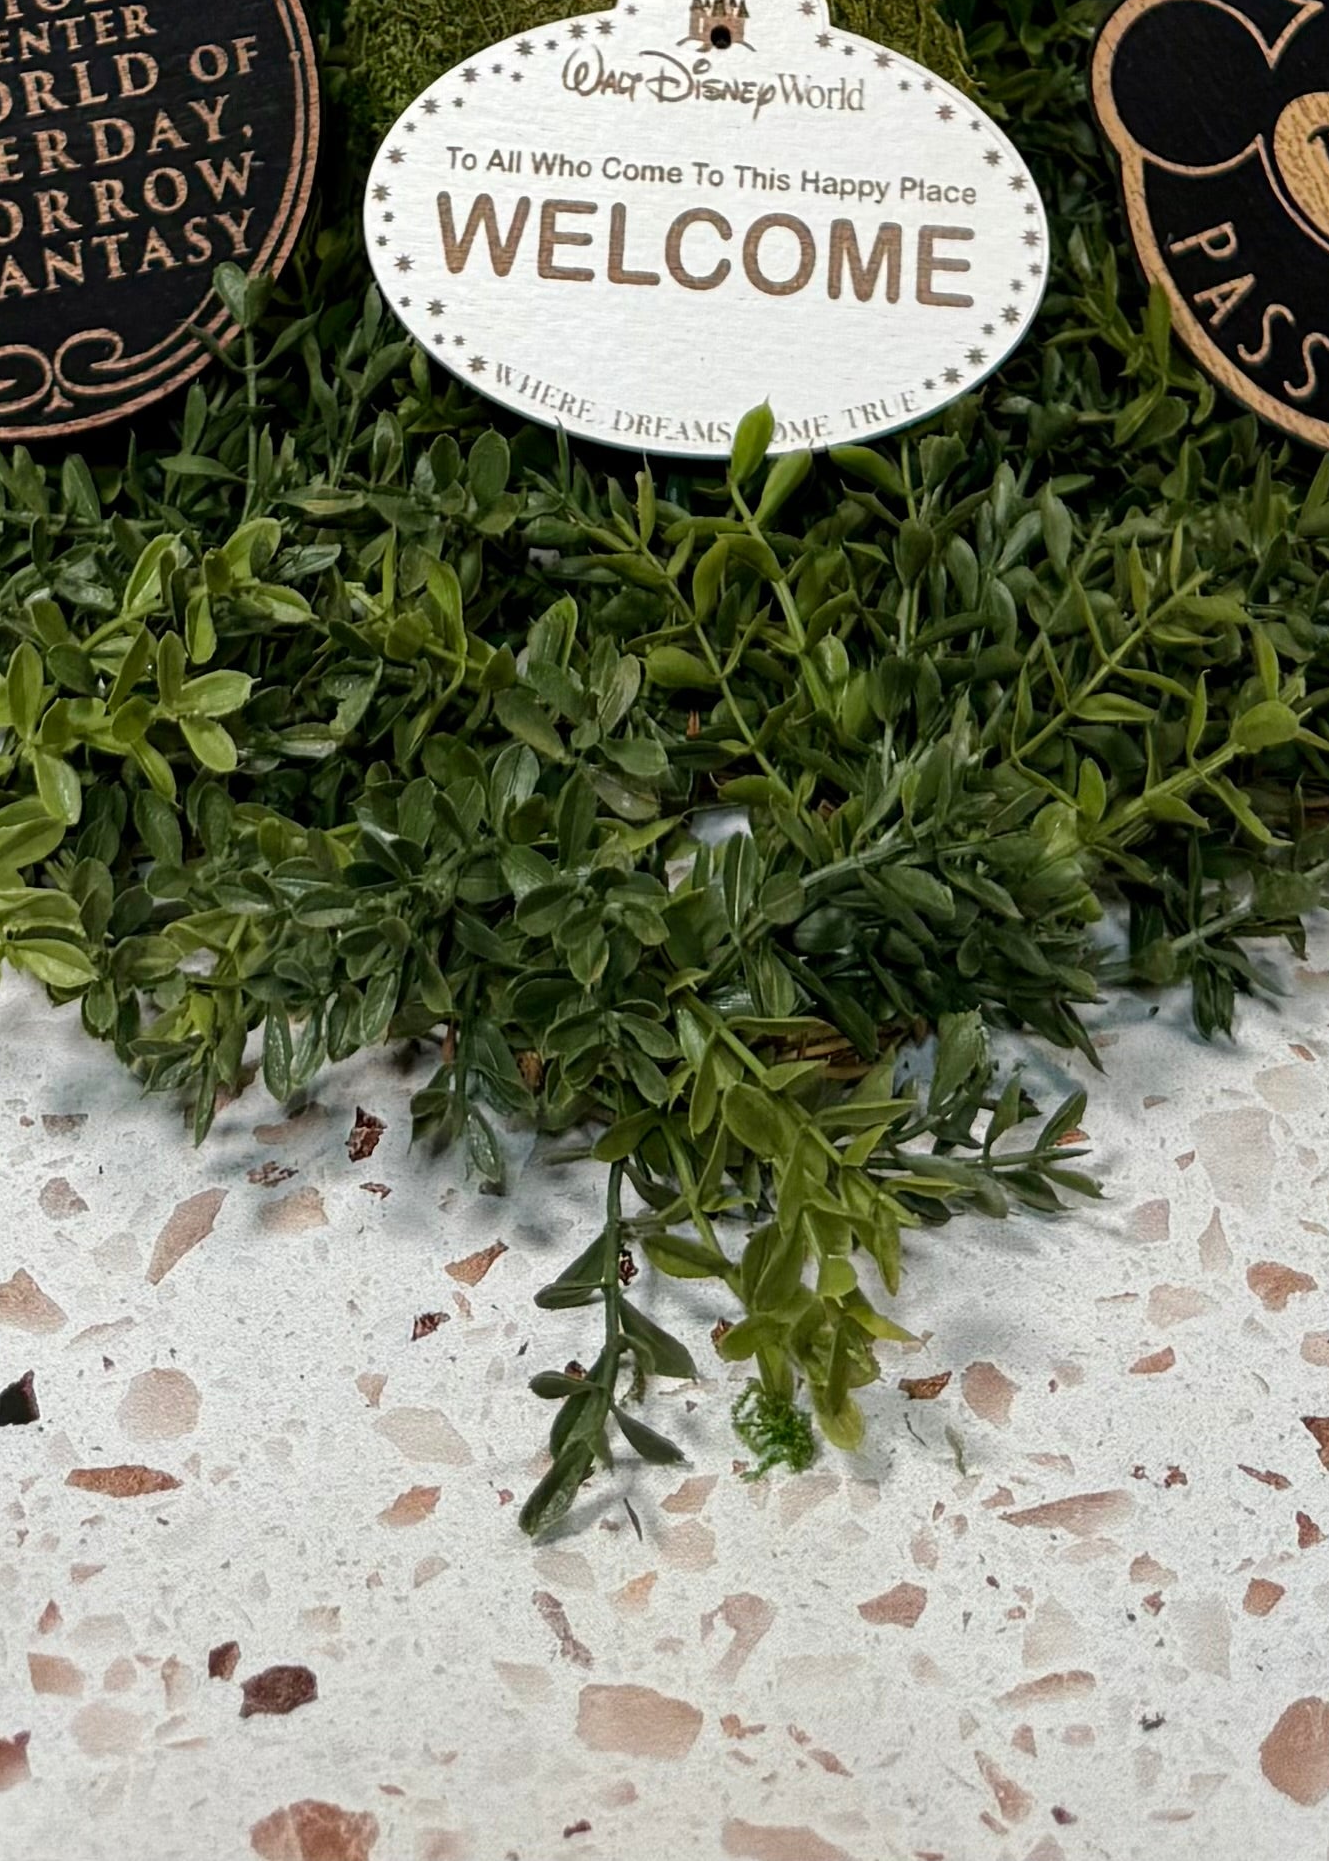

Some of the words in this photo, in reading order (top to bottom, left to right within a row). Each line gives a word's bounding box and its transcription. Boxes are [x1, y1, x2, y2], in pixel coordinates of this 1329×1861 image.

[187, 35, 259, 82] OF
[778, 73, 865, 111] World
[447, 146, 477, 172] To
[486, 149, 522, 174] All
[531, 152, 592, 178] Who
[601, 157, 684, 184] Come
[691, 162, 724, 187] To
[733, 165, 791, 192] This
[801, 170, 891, 203] Happy
[900, 175, 977, 205] Place
[436, 190, 976, 308] WELCOME
[496, 362, 596, 423] WHERE
[611, 409, 733, 445] DREAMS
[841, 390, 921, 429] TRUE
